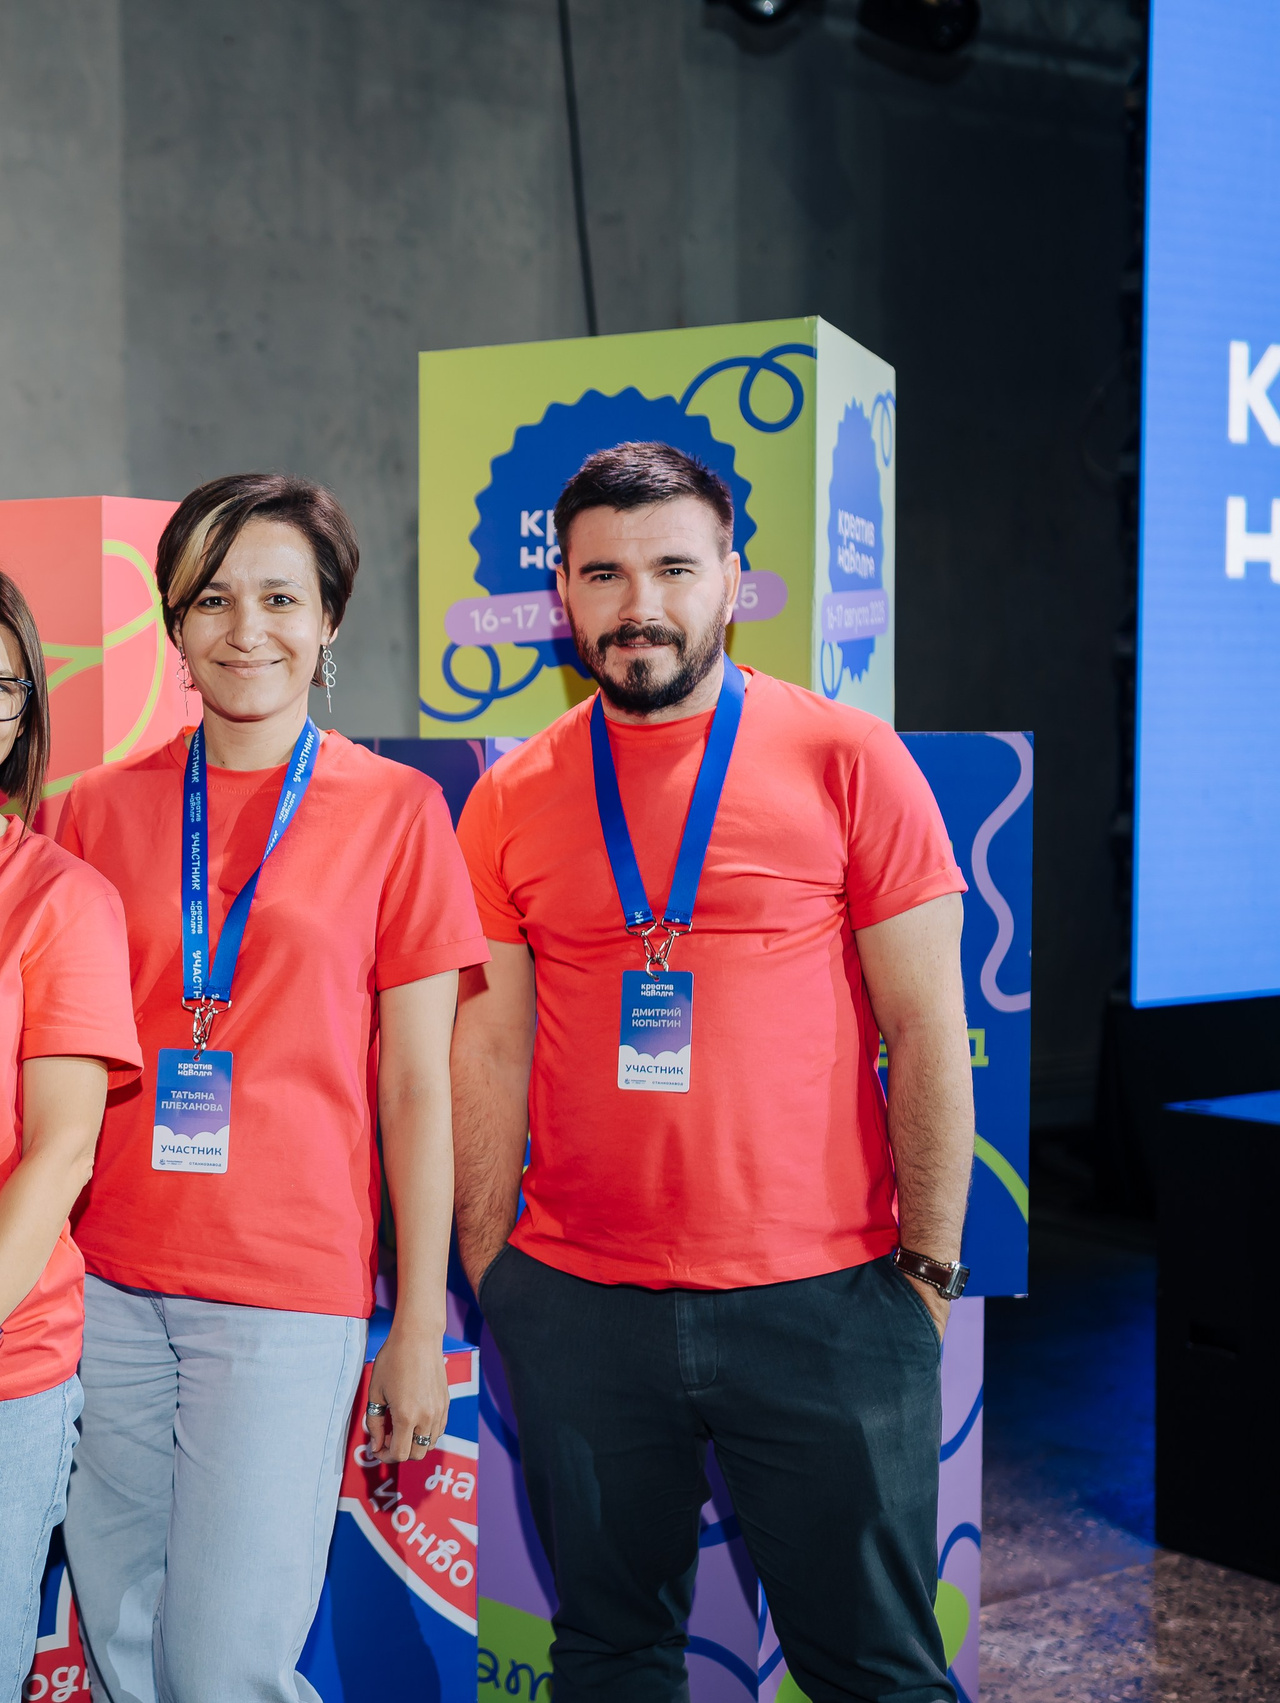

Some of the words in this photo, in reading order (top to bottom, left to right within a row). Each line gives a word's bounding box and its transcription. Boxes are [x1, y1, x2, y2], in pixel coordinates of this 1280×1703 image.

[470, 604, 539, 633] 16-17
[192, 950, 203, 999] УЧАСТН
[641, 983, 674, 992] креатив
[631, 1007, 682, 1018] ДМИТРИЙ
[632, 1019, 681, 1028] КОПЫТИН
[178, 1062, 212, 1071] креатив
[625, 1064, 684, 1075] УЧАСТНИК
[170, 1090, 215, 1101] ТАТЬЯНА
[161, 1101, 224, 1112] ПЛЕХАНОВА
[160, 1145, 222, 1156] УЧАСТНИК
